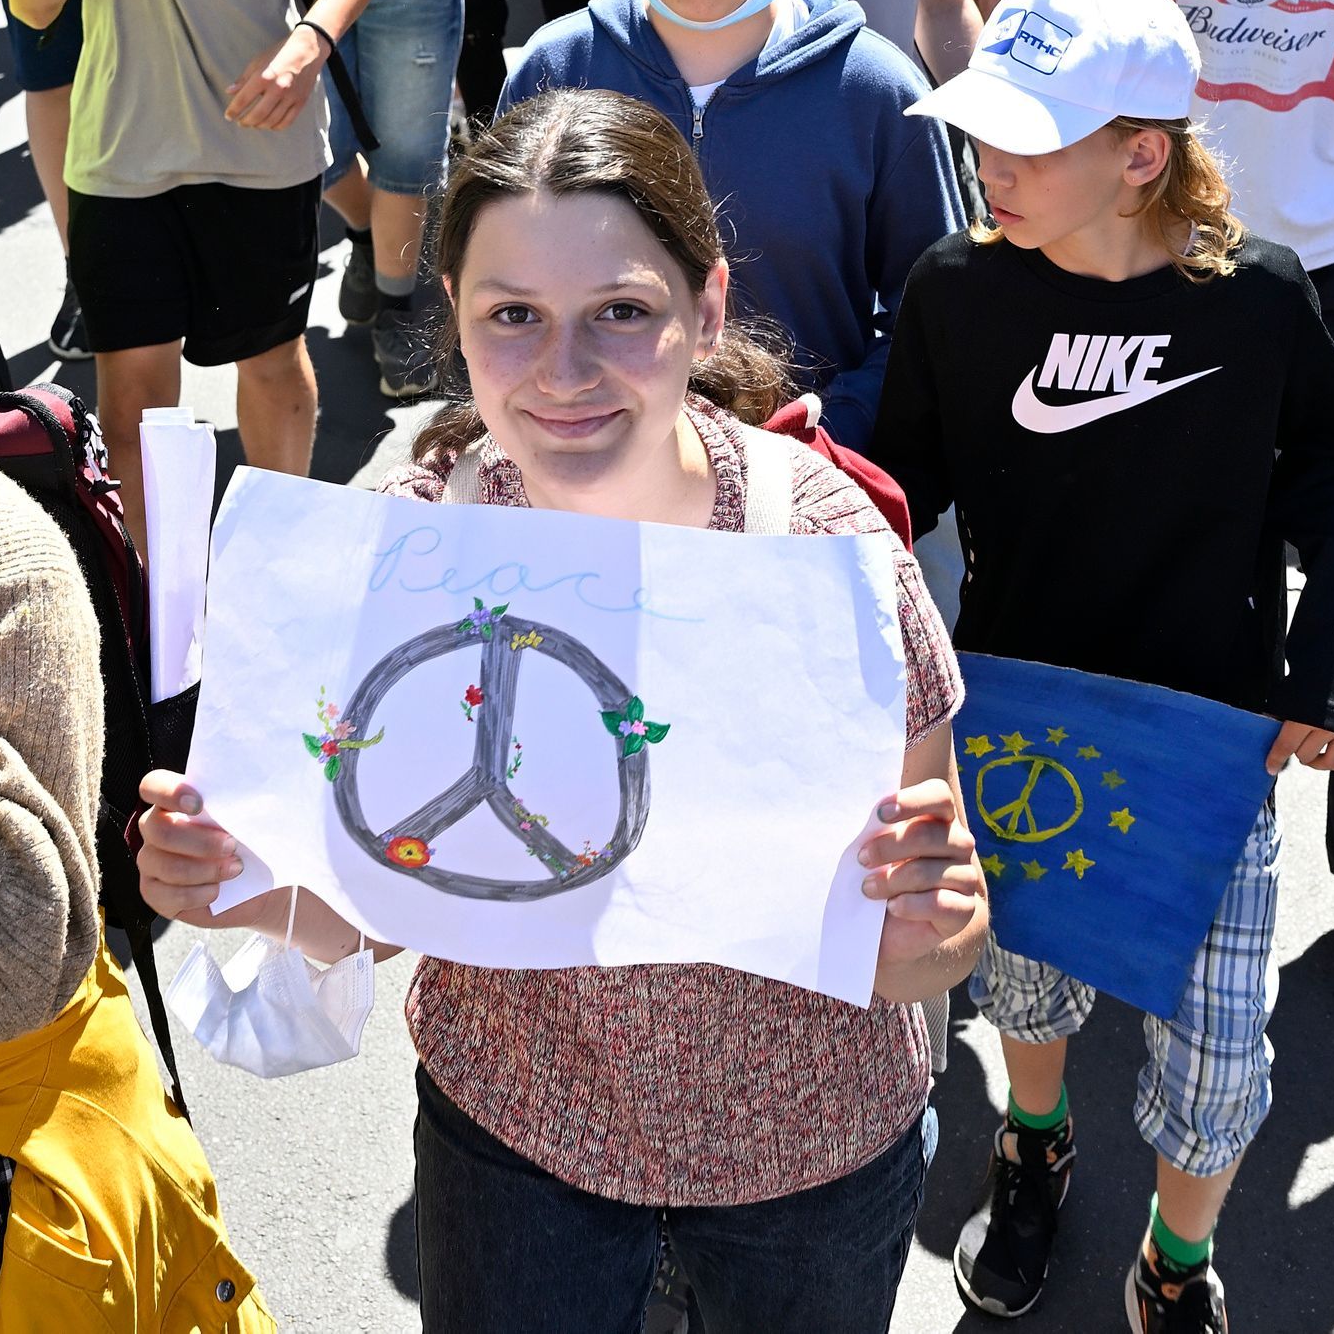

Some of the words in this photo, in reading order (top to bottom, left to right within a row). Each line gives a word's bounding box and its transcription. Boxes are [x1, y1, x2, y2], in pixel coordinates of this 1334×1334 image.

[1017, 30, 1063, 58] RTHC
[1178, 4, 1327, 53] Budweiser
[1037, 333, 1171, 393] NIKE
[368, 526, 707, 623] Peace
